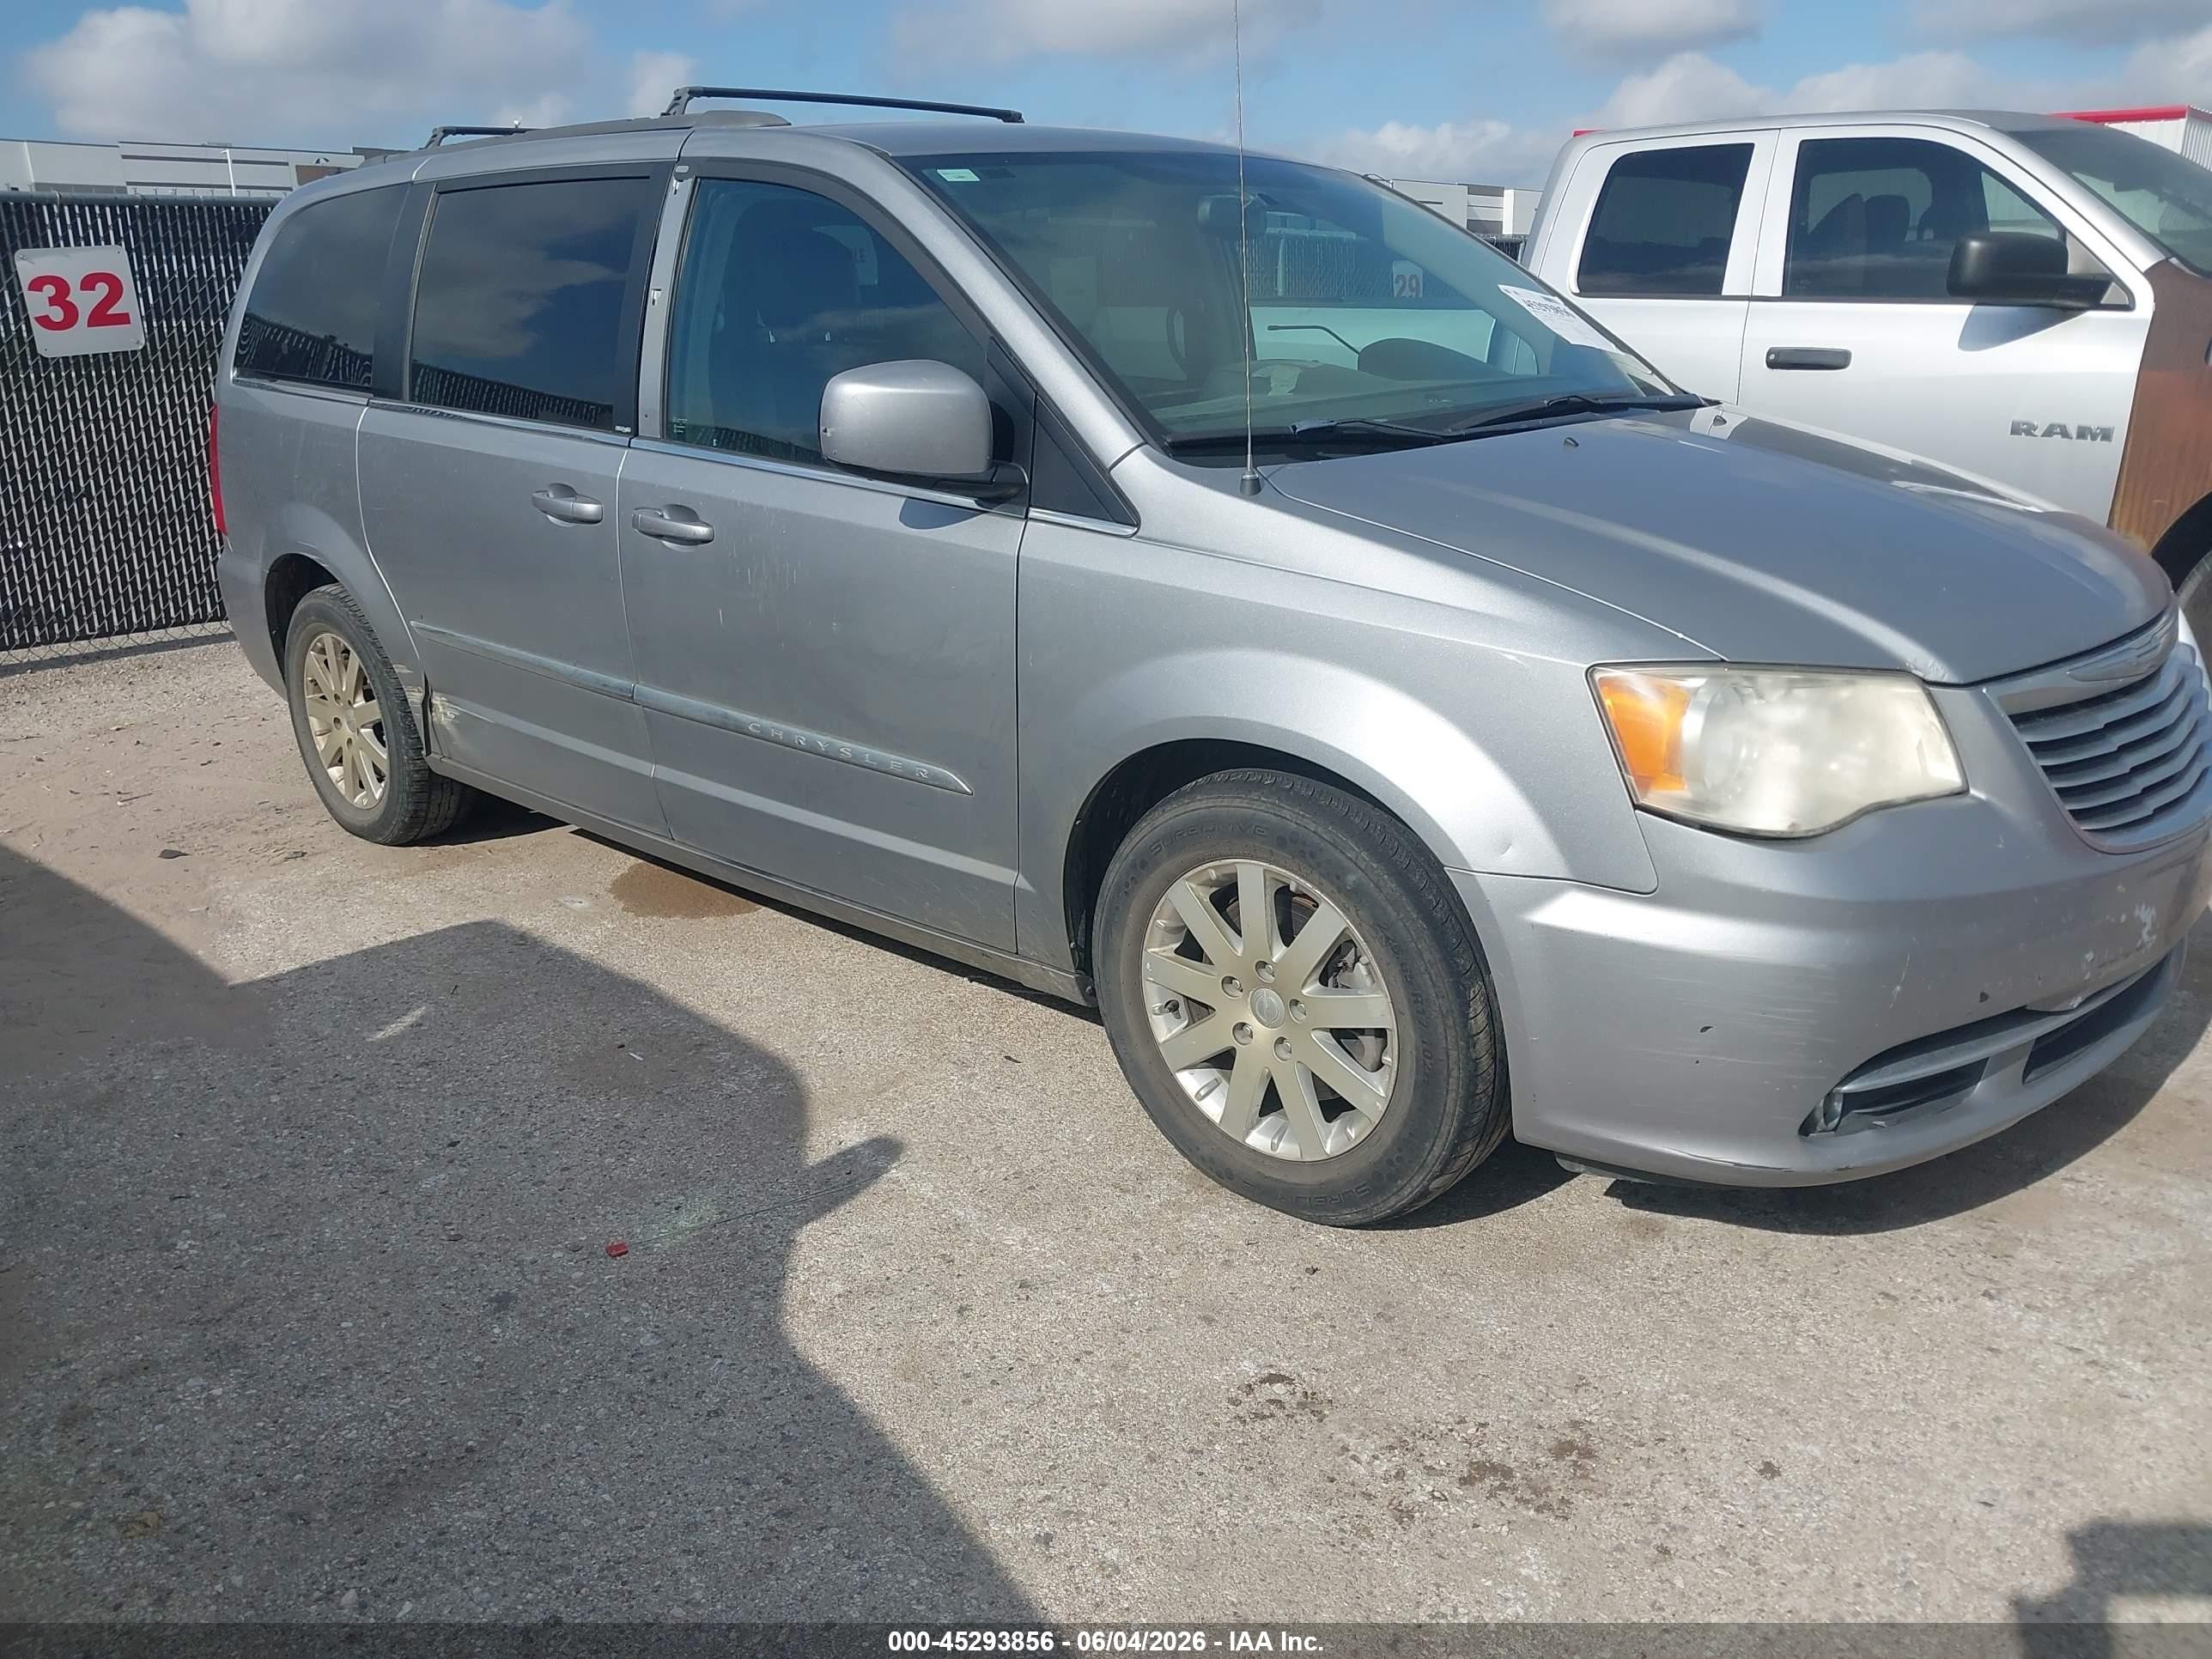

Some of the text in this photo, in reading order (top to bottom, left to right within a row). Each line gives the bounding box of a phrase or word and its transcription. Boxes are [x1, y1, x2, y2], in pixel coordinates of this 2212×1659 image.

[27, 271, 131, 331] 32
[2009, 419, 2116, 443] RAM
[747, 720, 930, 780] CHRYSLER
